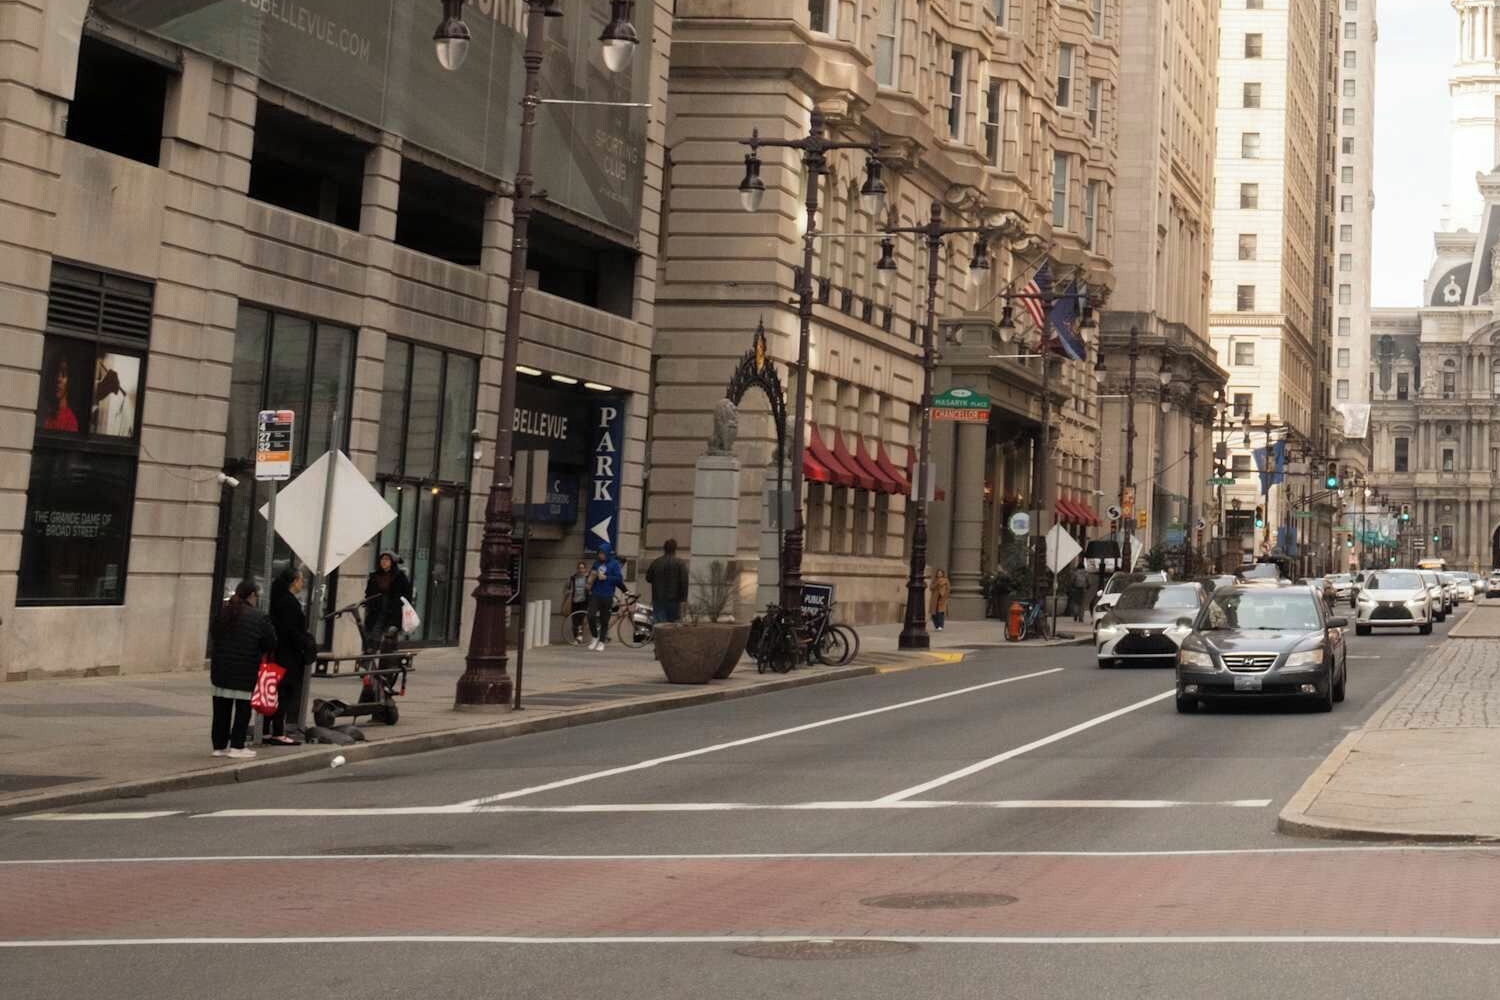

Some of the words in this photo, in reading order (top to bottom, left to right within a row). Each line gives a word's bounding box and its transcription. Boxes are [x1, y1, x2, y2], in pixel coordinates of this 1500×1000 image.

[512, 407, 568, 440] BELLEVUE
[259, 432, 271, 442] 27
[592, 406, 617, 501] PARK
[34, 510, 49, 524] THE
[102, 513, 113, 526] OF
[45, 524, 71, 537] BROAD
[72, 525, 99, 538] STREET
[804, 594, 825, 605] PUBLIC
